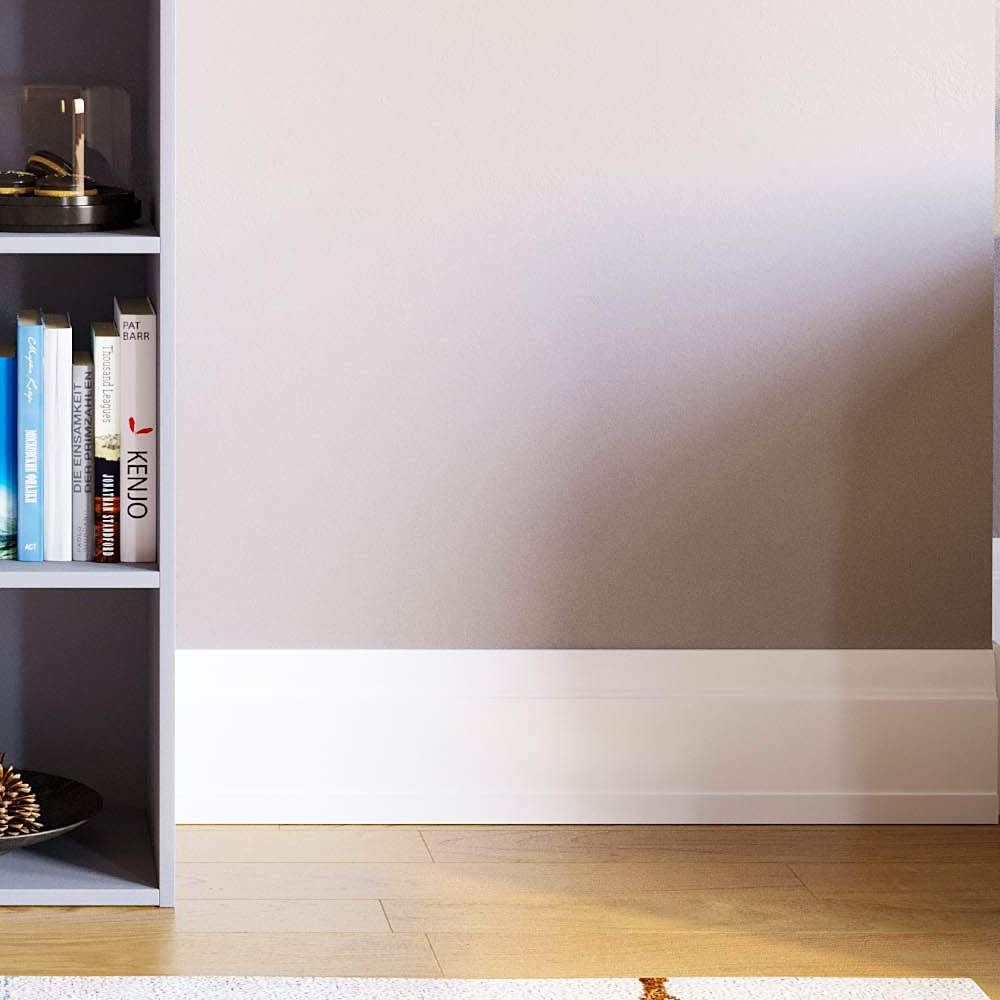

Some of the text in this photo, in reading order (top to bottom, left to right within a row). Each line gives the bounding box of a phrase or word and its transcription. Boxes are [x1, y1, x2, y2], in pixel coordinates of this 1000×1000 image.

[122, 321, 141, 330] PAT
[122, 331, 150, 341] BARR
[100, 345, 114, 423] Thousand Leagues
[73, 383, 82, 494] DIE EINSAMKEIT
[83, 371, 93, 494] DER PRIMZAHLEN
[102, 473, 114, 557] JONATHAN STANDFORD
[127, 451, 148, 519] KENJO
